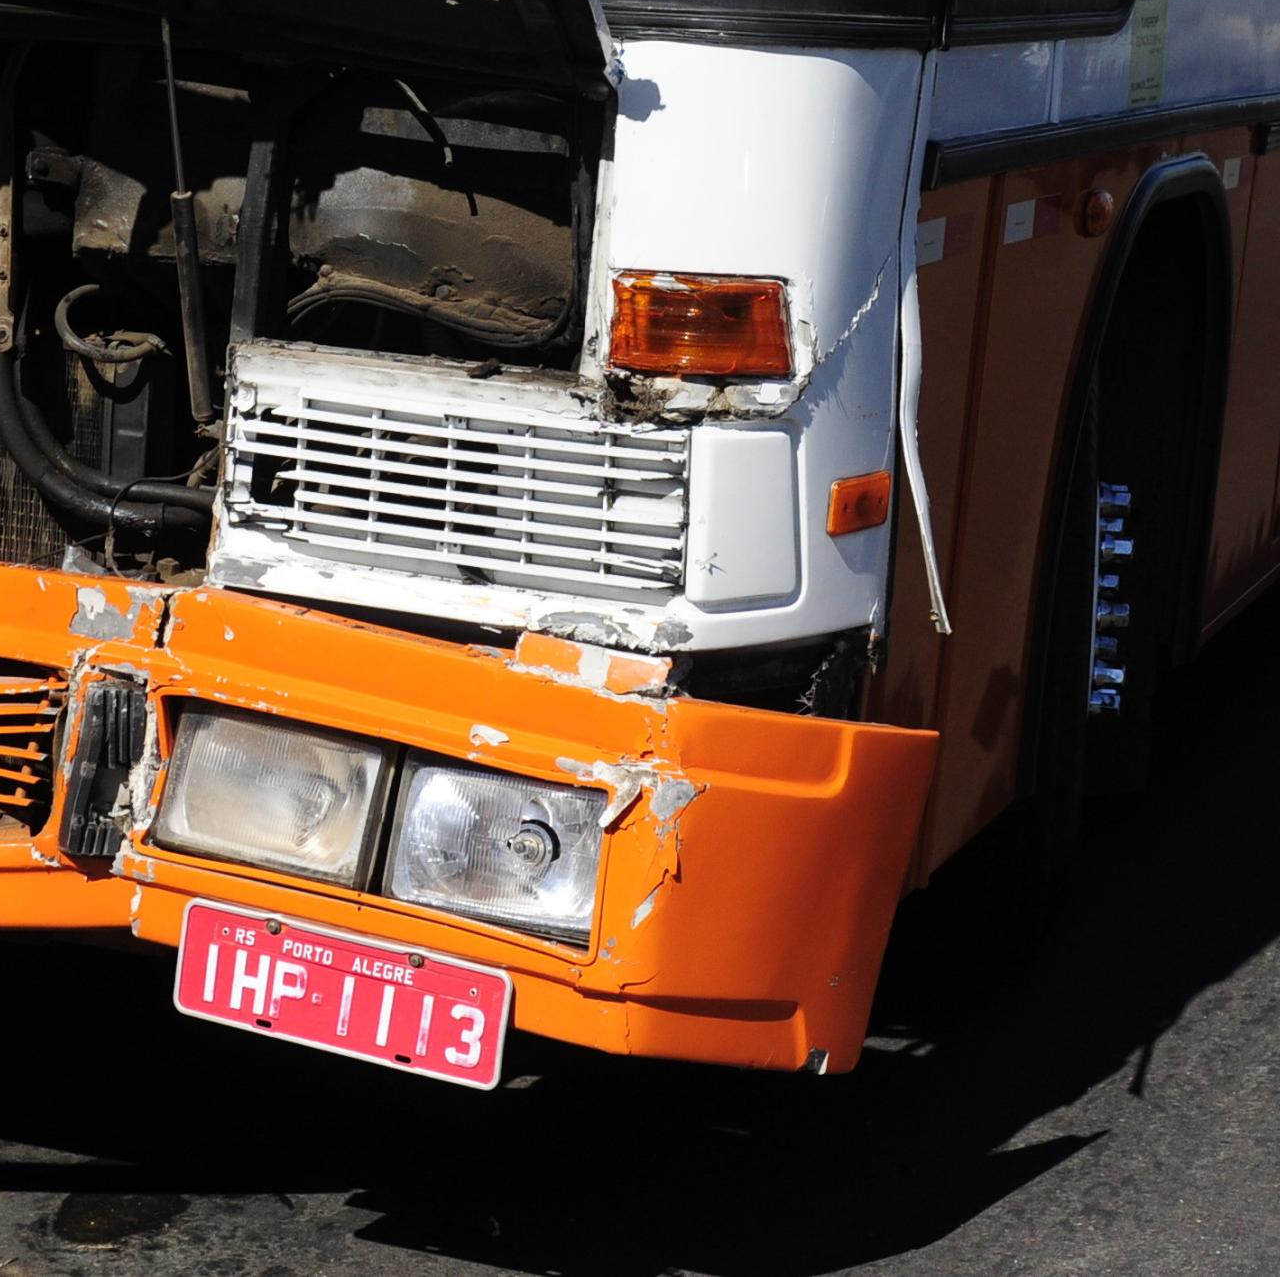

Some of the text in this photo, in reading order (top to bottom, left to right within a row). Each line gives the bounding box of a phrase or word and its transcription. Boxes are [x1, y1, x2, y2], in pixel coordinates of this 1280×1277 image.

[234, 927, 415, 986] RS PORTO ALEGRE
